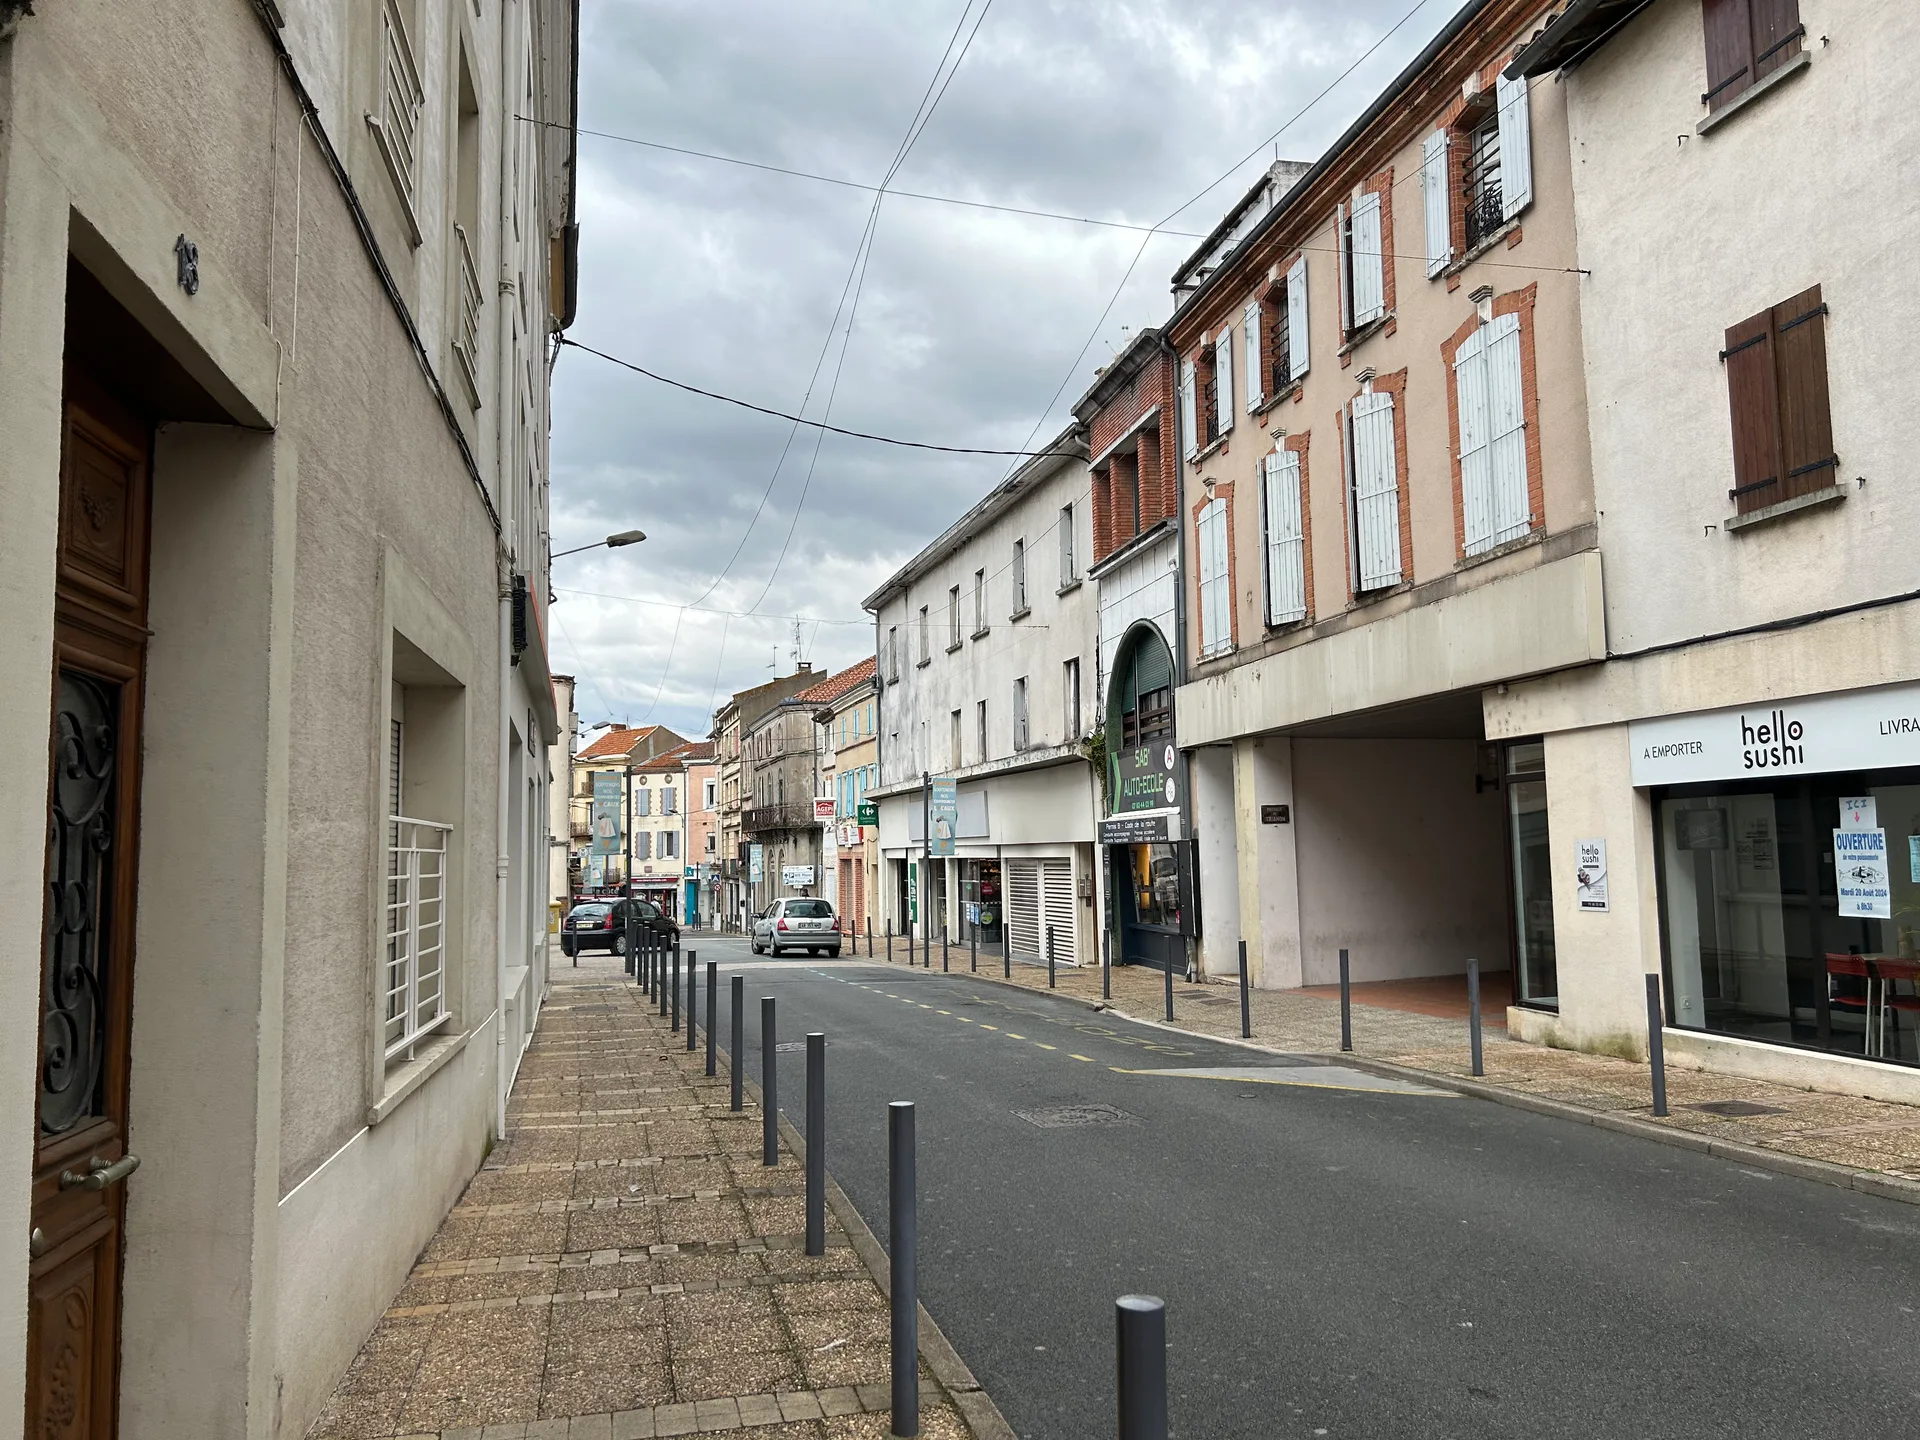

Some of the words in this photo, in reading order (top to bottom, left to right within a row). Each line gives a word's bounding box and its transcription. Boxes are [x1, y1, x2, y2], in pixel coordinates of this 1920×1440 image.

[174, 233, 199, 296] 18
[1741, 710, 1804, 746] hello
[1644, 748, 1651, 760] A
[1652, 741, 1703, 759] EMPORTER
[1743, 745, 1804, 770] sushi
[1845, 799, 1867, 810] ICI
[1836, 833, 1884, 851] OUVERTURE
[1581, 844, 1600, 856] hello
[1582, 855, 1599, 863] sushi
[1840, 888, 1855, 896] Mardi
[1855, 888, 1862, 896] 20
[1875, 889, 1888, 897] 2024
[1860, 902, 1873, 911] 8h30
